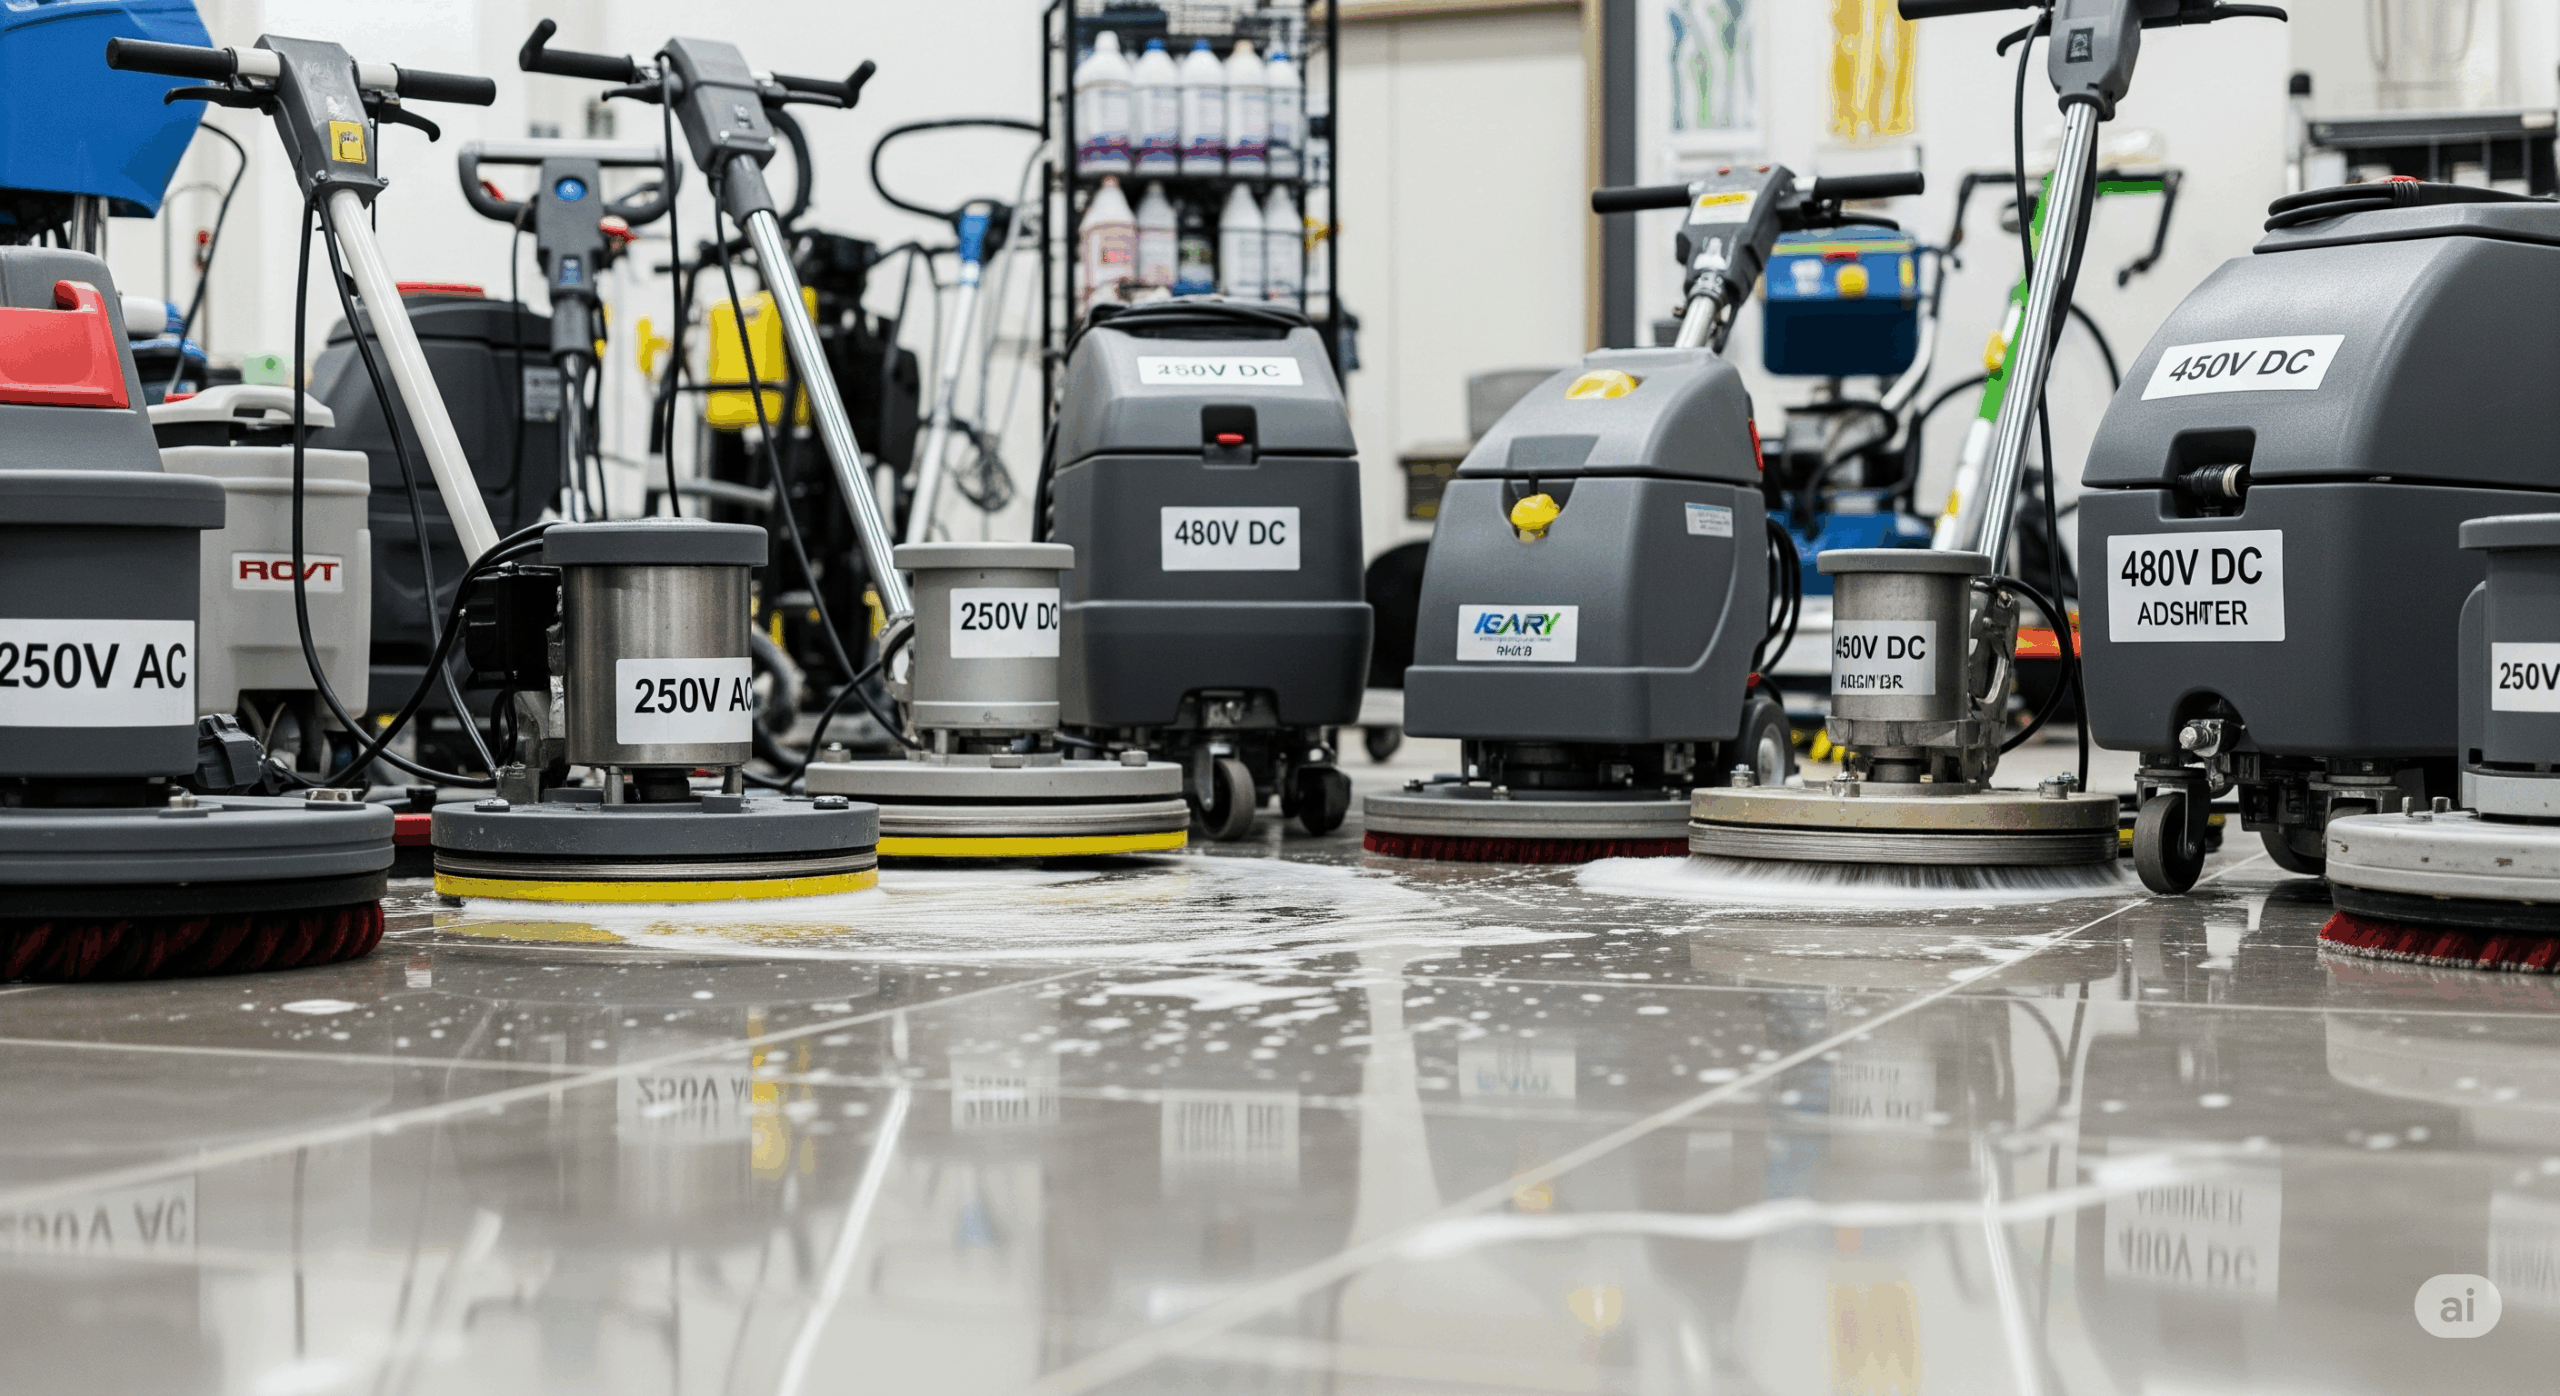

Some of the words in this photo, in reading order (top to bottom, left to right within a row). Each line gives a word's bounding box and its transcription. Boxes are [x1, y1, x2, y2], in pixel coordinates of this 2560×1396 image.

[1238, 363, 1281, 378] DC
[2169, 350, 2258, 382] 450V
[2256, 348, 2315, 376] DC
[1174, 519, 1239, 546] 480V
[1249, 519, 1286, 546] DC
[2121, 548, 2200, 587] 480V
[2211, 546, 2263, 585] DC
[961, 602, 1028, 630] 250V
[1037, 602, 1058, 630] DC
[1836, 634, 1878, 660] 450V
[1887, 634, 1926, 661] DC
[0, 641, 120, 689] 250V
[132, 643, 187, 689] AC
[2499, 661, 2560, 691] 250V
[634, 677, 721, 714] 250V
